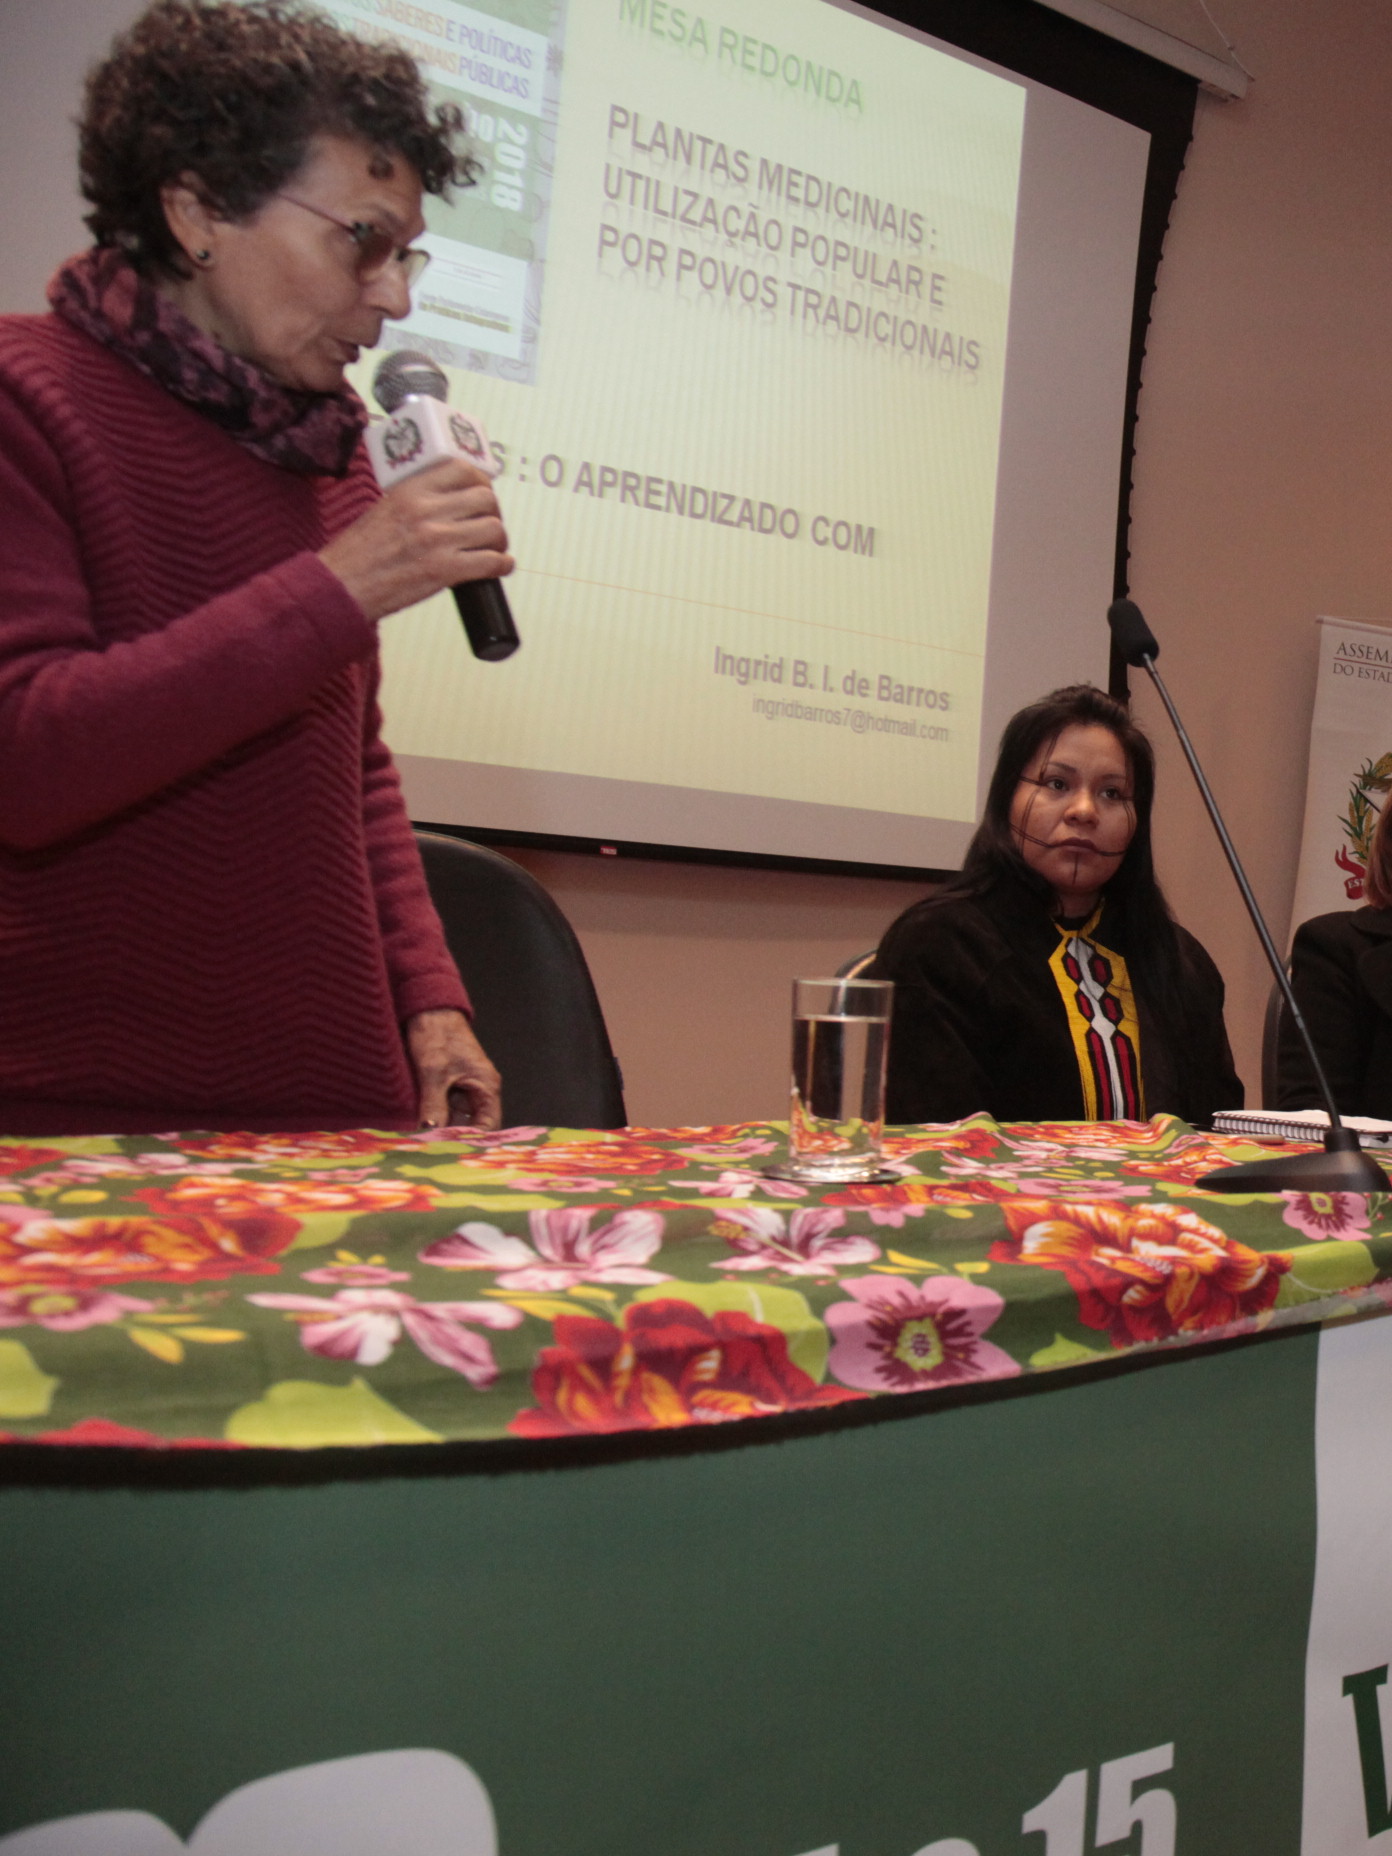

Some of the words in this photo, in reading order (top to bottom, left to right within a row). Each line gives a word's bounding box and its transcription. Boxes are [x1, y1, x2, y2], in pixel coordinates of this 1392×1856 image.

[459, 28, 532, 70] POLÍTICAS
[459, 54, 529, 99] PÚBLICAS
[619, 0, 708, 54] MESA
[717, 26, 862, 113] REDONDA
[492, 116, 529, 212] 2018
[608, 104, 749, 183] PLANTAS
[604, 163, 782, 251] UTILIZAÇÃO
[791, 225, 923, 299] POPULAR
[930, 272, 946, 306] E
[599, 223, 667, 277] POR
[676, 247, 778, 308] POVOS
[787, 282, 980, 370] TRADICIONAIS
[540, 454, 563, 488] O
[572, 461, 800, 539] APRENDIZADO
[811, 515, 875, 557] COM
[714, 645, 784, 686] Ingrid
[792, 659, 815, 690] B.
[842, 669, 870, 698] de
[876, 674, 951, 711] Barros
[1332, 662, 1354, 676] DO
